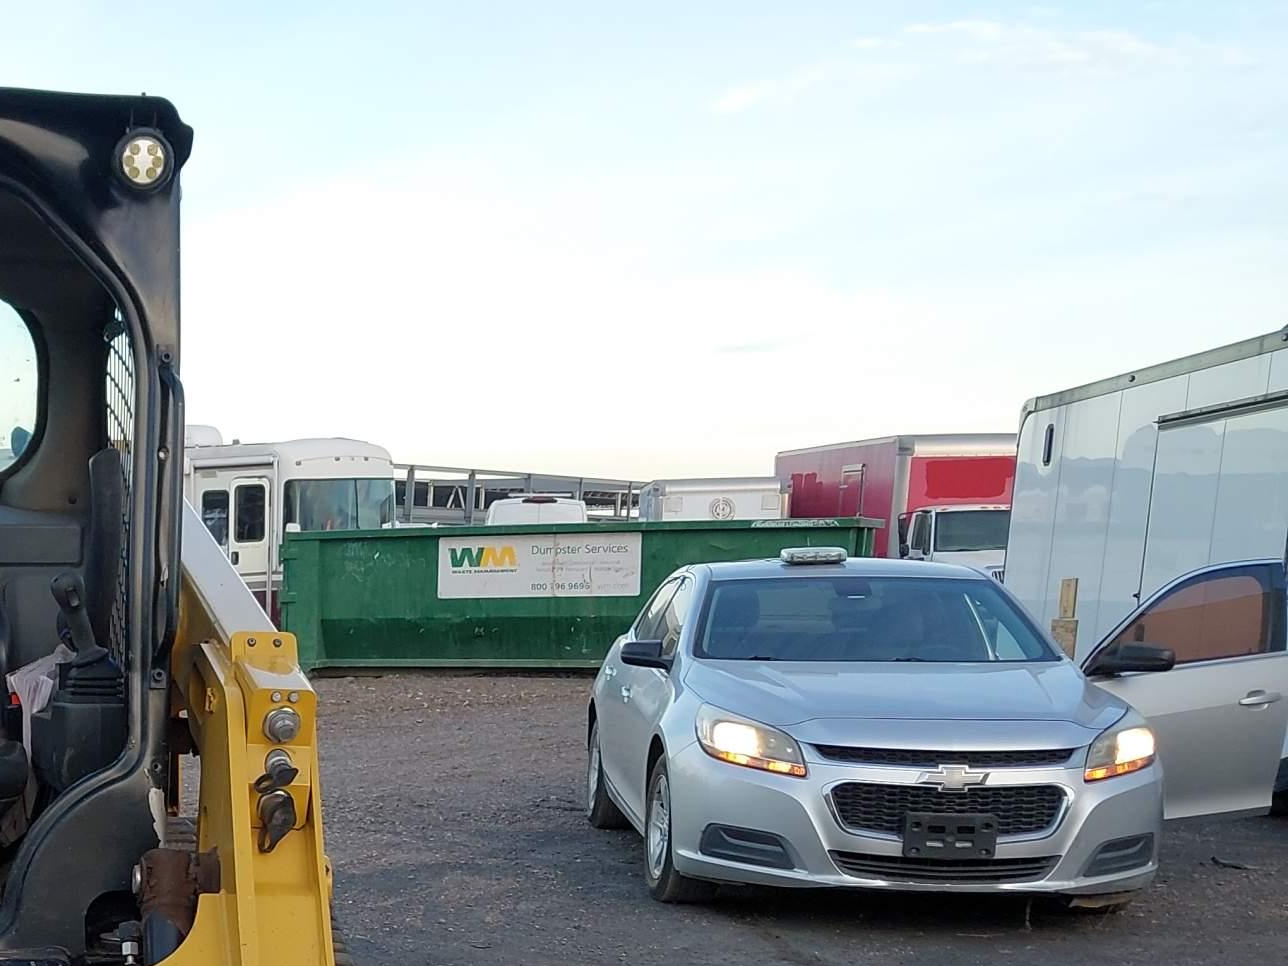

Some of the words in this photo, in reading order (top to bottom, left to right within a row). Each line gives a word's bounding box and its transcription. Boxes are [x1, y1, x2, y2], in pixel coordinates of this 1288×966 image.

[448, 545, 518, 568] WM
[531, 545, 581, 557] Dumpster
[584, 544, 629, 554] Services
[530, 583, 548, 591] 800
